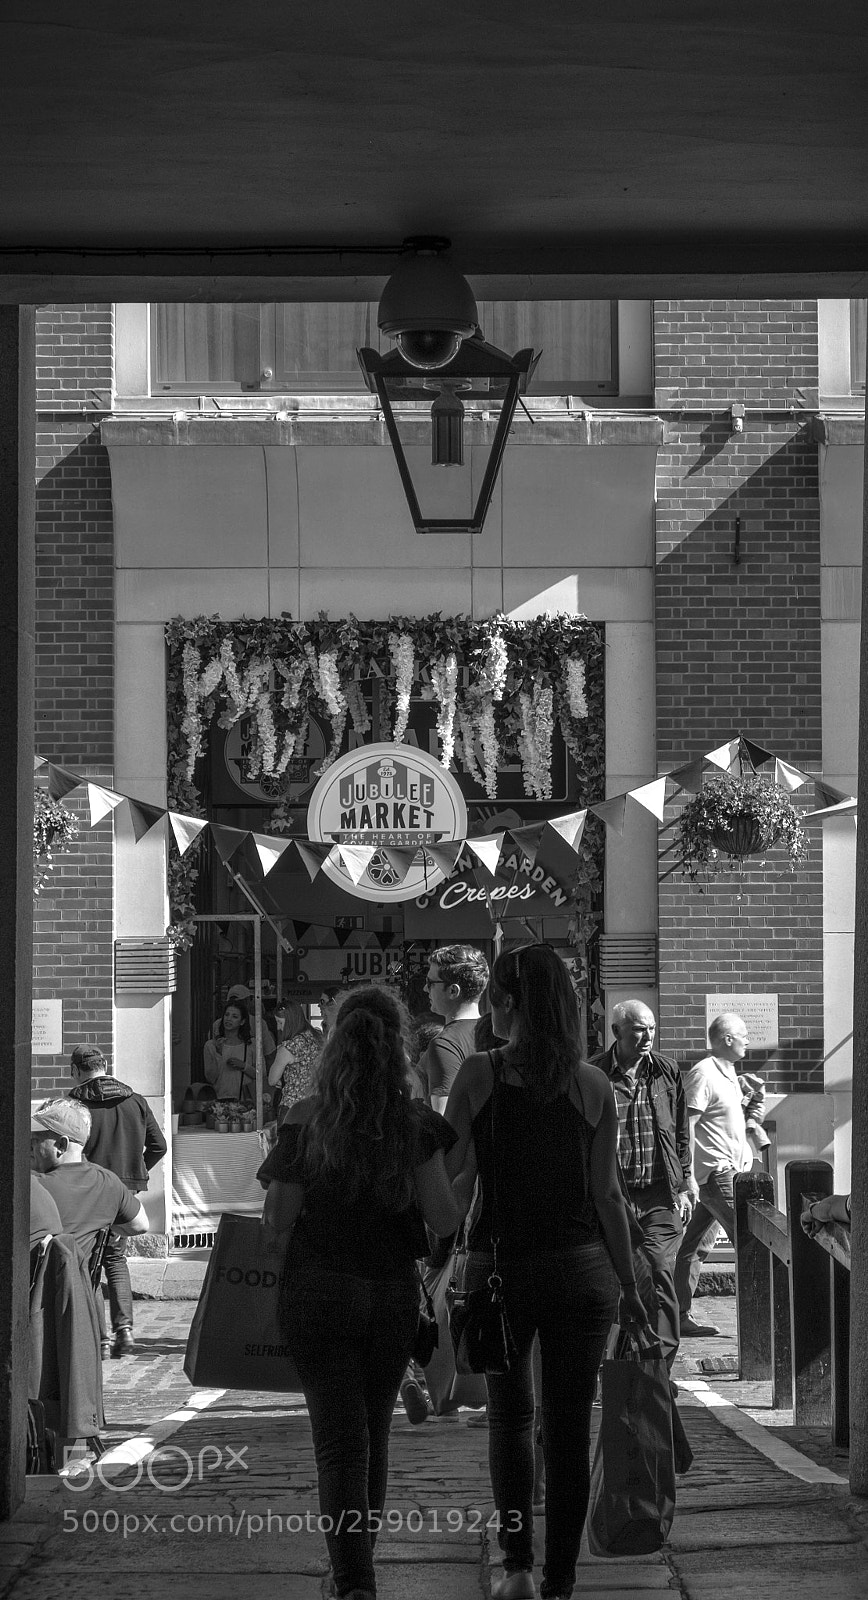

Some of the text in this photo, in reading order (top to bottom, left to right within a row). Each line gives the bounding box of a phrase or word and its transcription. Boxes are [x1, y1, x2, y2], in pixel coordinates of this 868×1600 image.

[342, 783, 432, 806] JUBILEE
[340, 803, 435, 829] MARKET
[439, 881, 536, 909] Crepes
